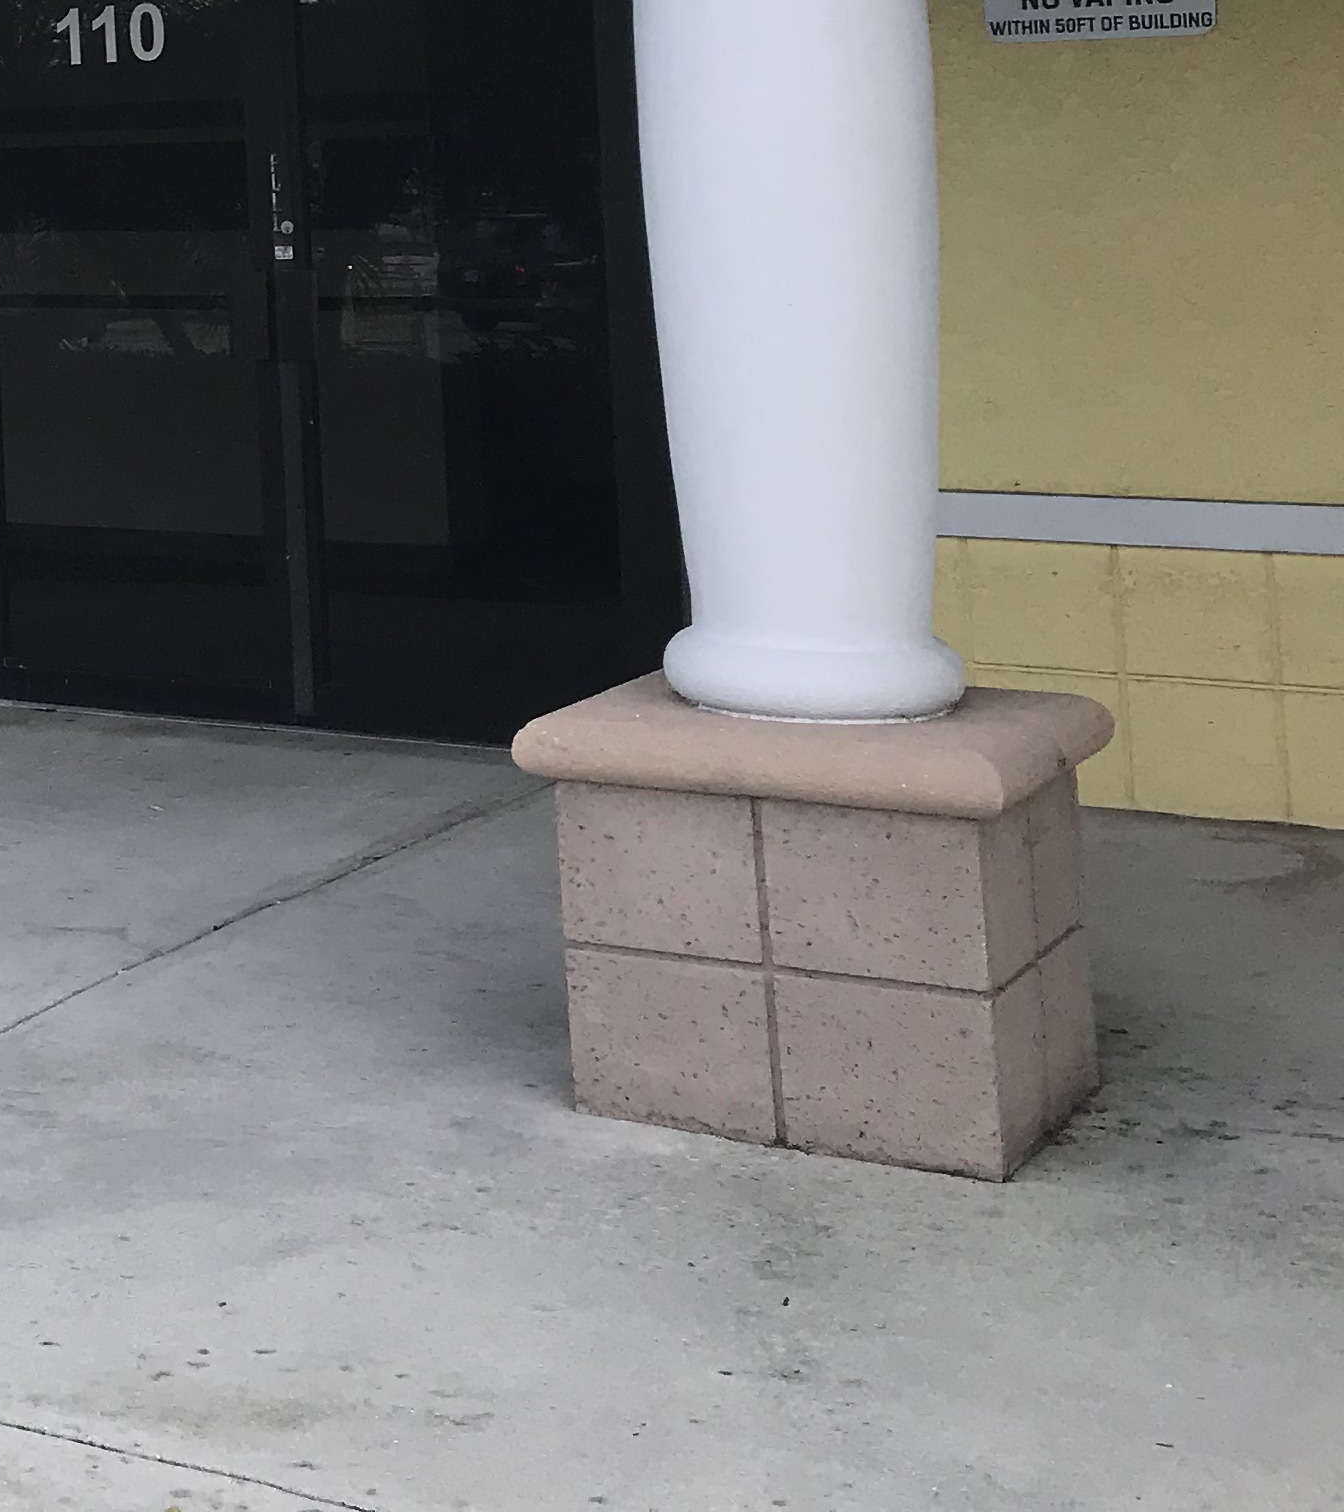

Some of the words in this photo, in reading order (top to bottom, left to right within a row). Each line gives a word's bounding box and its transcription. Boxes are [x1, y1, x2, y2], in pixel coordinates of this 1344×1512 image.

[56, 3, 166, 66] 110
[989, 19, 1050, 37] WITHIN
[1055, 17, 1095, 34] 50FT
[1101, 16, 1124, 31] OF
[1128, 12, 1213, 30] BUILDING
